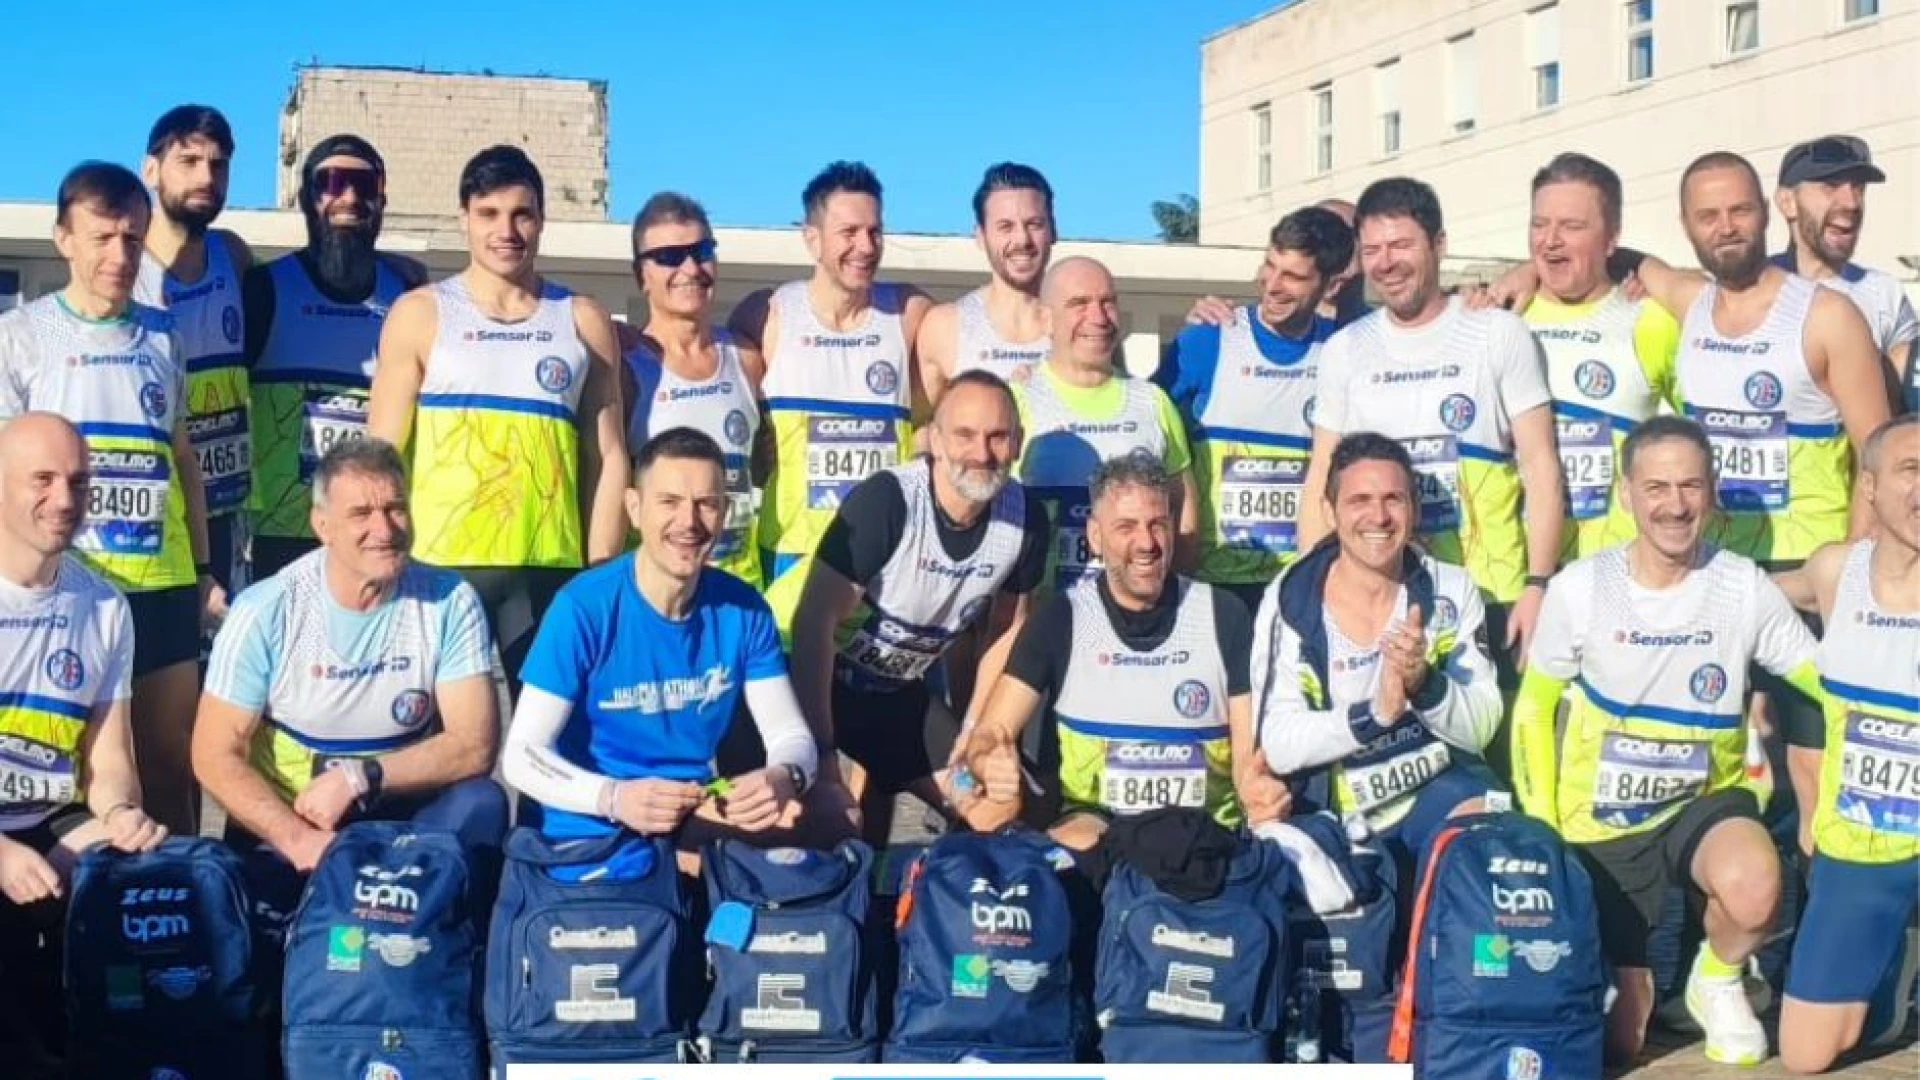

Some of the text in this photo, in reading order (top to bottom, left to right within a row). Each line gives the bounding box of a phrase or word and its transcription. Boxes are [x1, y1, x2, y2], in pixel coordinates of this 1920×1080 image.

[477, 330, 533, 342] Sensor
[815, 335, 863, 348] Sensor
[991, 350, 1042, 360] Sensor
[1703, 339, 1750, 355] Sensor
[81, 353, 136, 366] Sensor
[1254, 366, 1306, 379] Sensor
[1383, 368, 1438, 383] Sensor
[669, 383, 718, 401] Sensor
[816, 418, 885, 437] COELMO
[1068, 421, 1121, 434] Sensor
[1705, 412, 1772, 430] COELMO
[195, 446, 237, 475] 465
[824, 450, 881, 477] 8470
[1232, 460, 1303, 477] COELMO
[90, 485, 151, 518] 8490
[1239, 489, 1296, 518] 8486
[1629, 631, 1693, 647] Sensor
[1112, 652, 1169, 667] Sensor
[1118, 745, 1192, 759] COELMO
[1614, 739, 1693, 759] COELMO
[1369, 756, 1430, 800] 8480
[1124, 777, 1187, 806] 8487
[355, 879, 418, 911] bpm
[1492, 883, 1554, 914] bpm
[971, 900, 1031, 933] bpm
[122, 911, 190, 943] bpm
